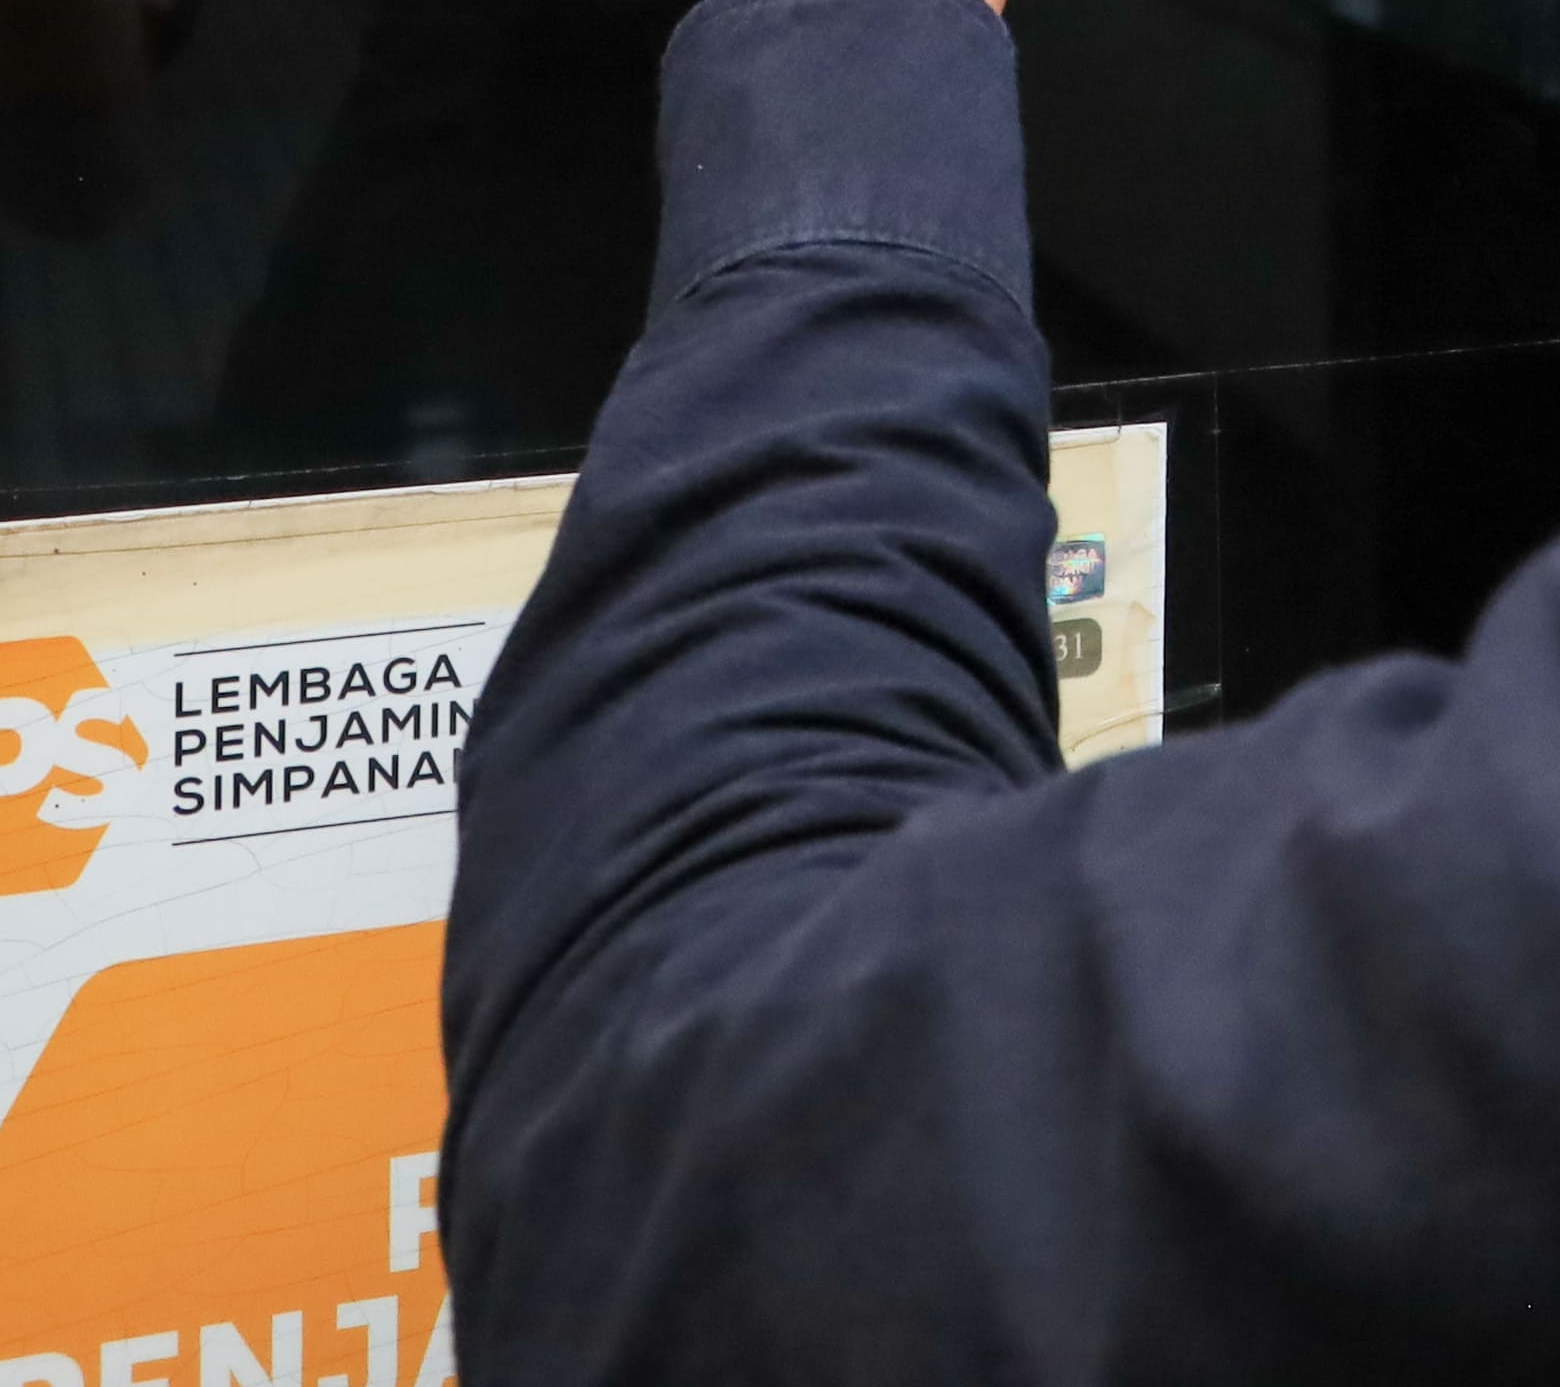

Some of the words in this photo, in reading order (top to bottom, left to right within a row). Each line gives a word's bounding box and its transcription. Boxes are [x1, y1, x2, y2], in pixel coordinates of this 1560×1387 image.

[175, 654, 462, 718] LEMBAGA
[174, 698, 478, 767] PENJAMIN
[172, 747, 461, 816] SIMPANA
